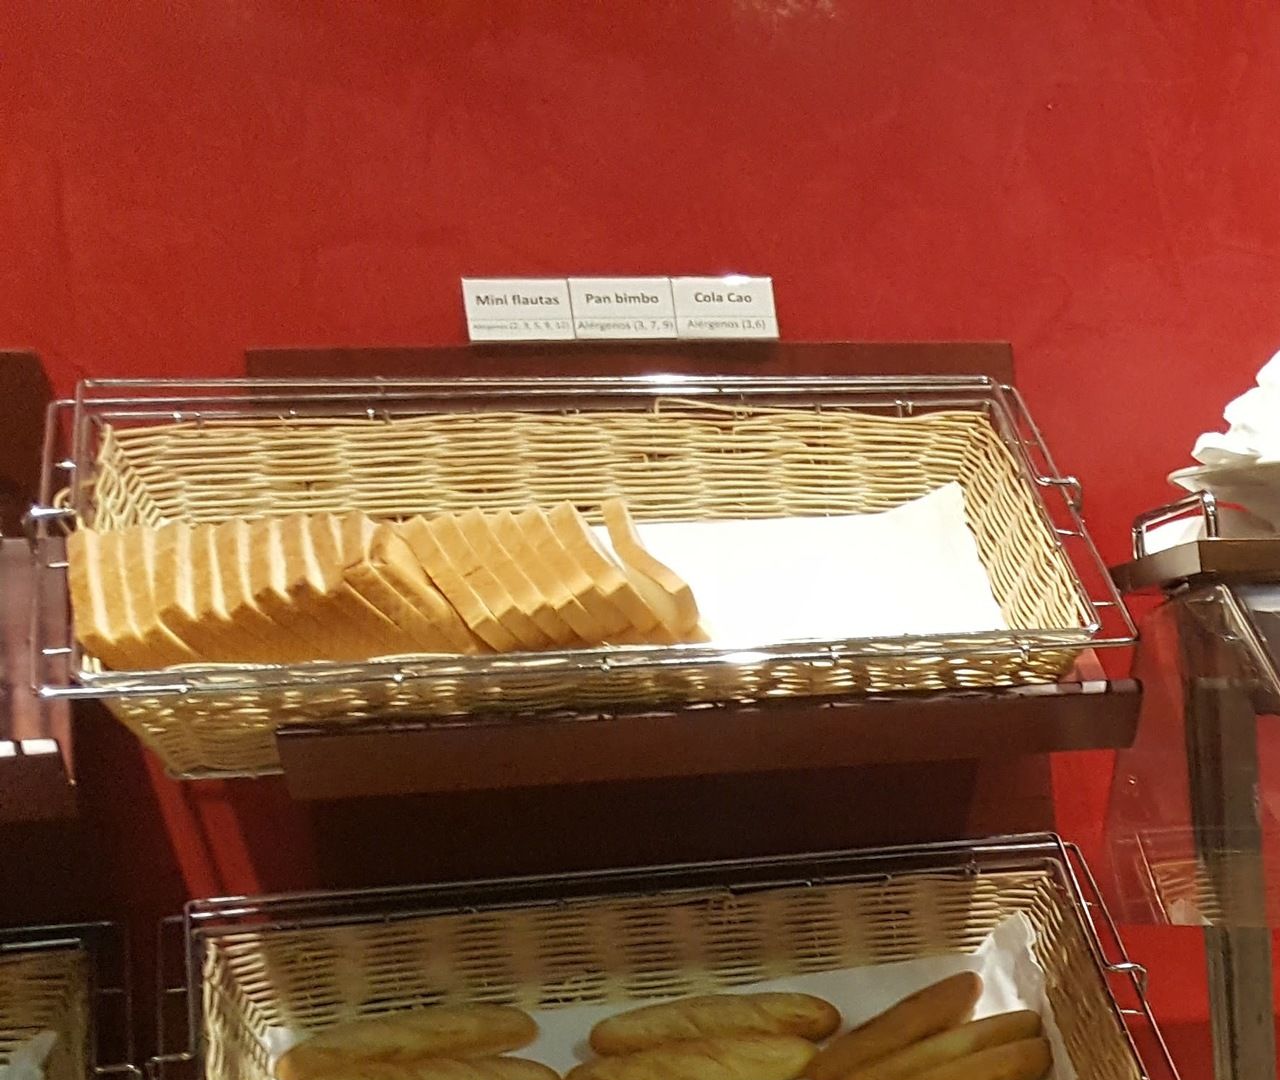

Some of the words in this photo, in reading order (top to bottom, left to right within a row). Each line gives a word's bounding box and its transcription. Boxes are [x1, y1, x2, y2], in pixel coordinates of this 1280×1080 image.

[475, 295, 508, 306] Mini
[512, 294, 560, 306] flautas
[585, 293, 611, 304] Pan
[615, 292, 659, 304] bimbo
[694, 292, 723, 303] Cola
[727, 292, 752, 303] Cao
